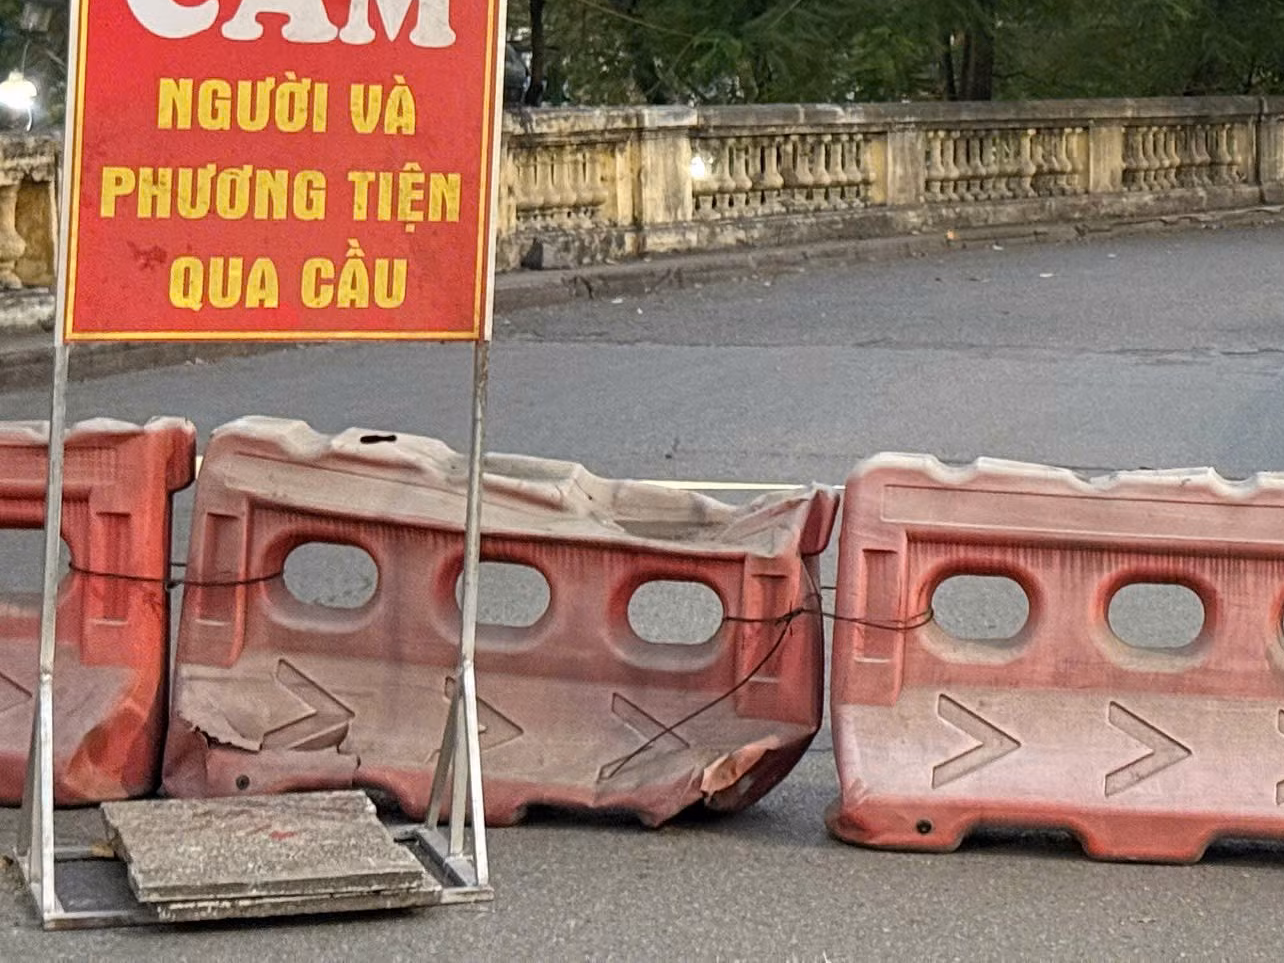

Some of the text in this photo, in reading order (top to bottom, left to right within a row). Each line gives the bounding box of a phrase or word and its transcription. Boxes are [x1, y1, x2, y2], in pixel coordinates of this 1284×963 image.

[157, 71, 417, 135] NGƯỜI VÀ
[100, 162, 461, 232] PHƯƠNG TIỆN
[168, 238, 409, 311] QUA CẦU
